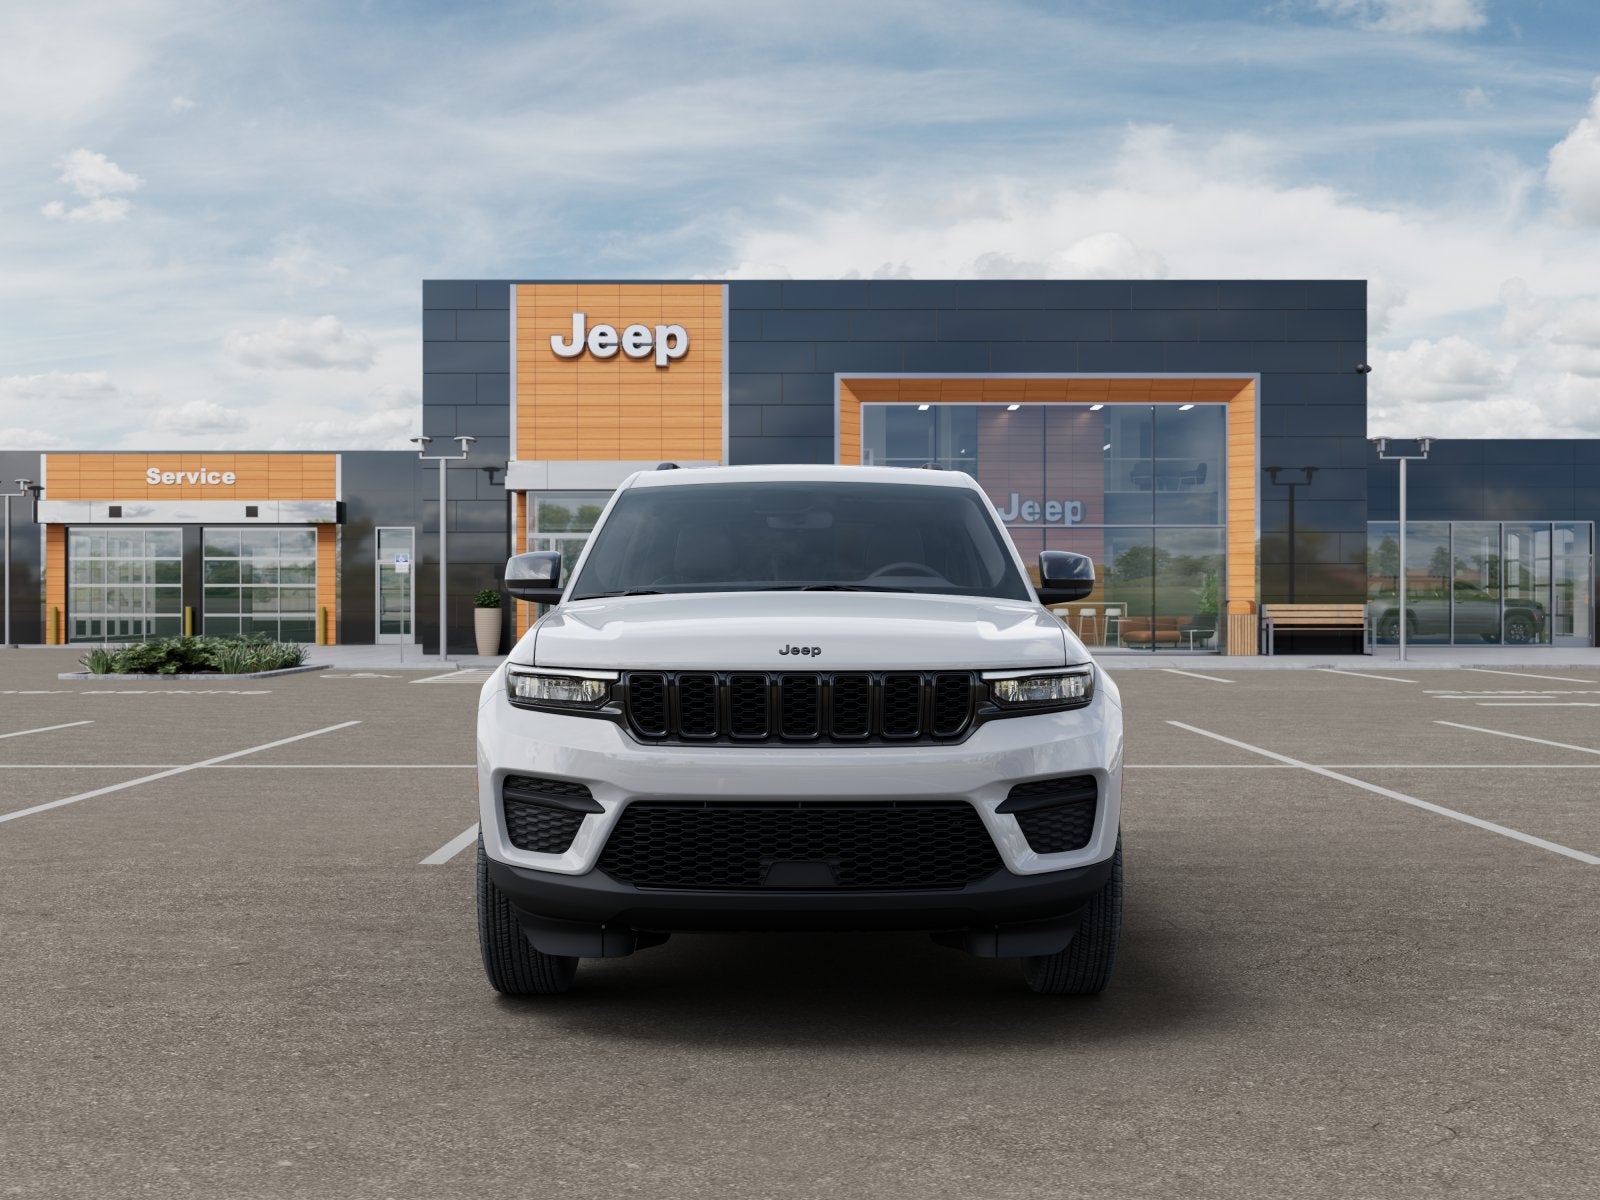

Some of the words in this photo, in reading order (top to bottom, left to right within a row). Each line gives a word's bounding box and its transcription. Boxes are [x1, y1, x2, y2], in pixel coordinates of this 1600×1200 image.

[550, 312, 689, 367] Jeep
[146, 467, 236, 485] Service
[997, 493, 1083, 526] Jeep
[779, 644, 821, 657] Jeep
